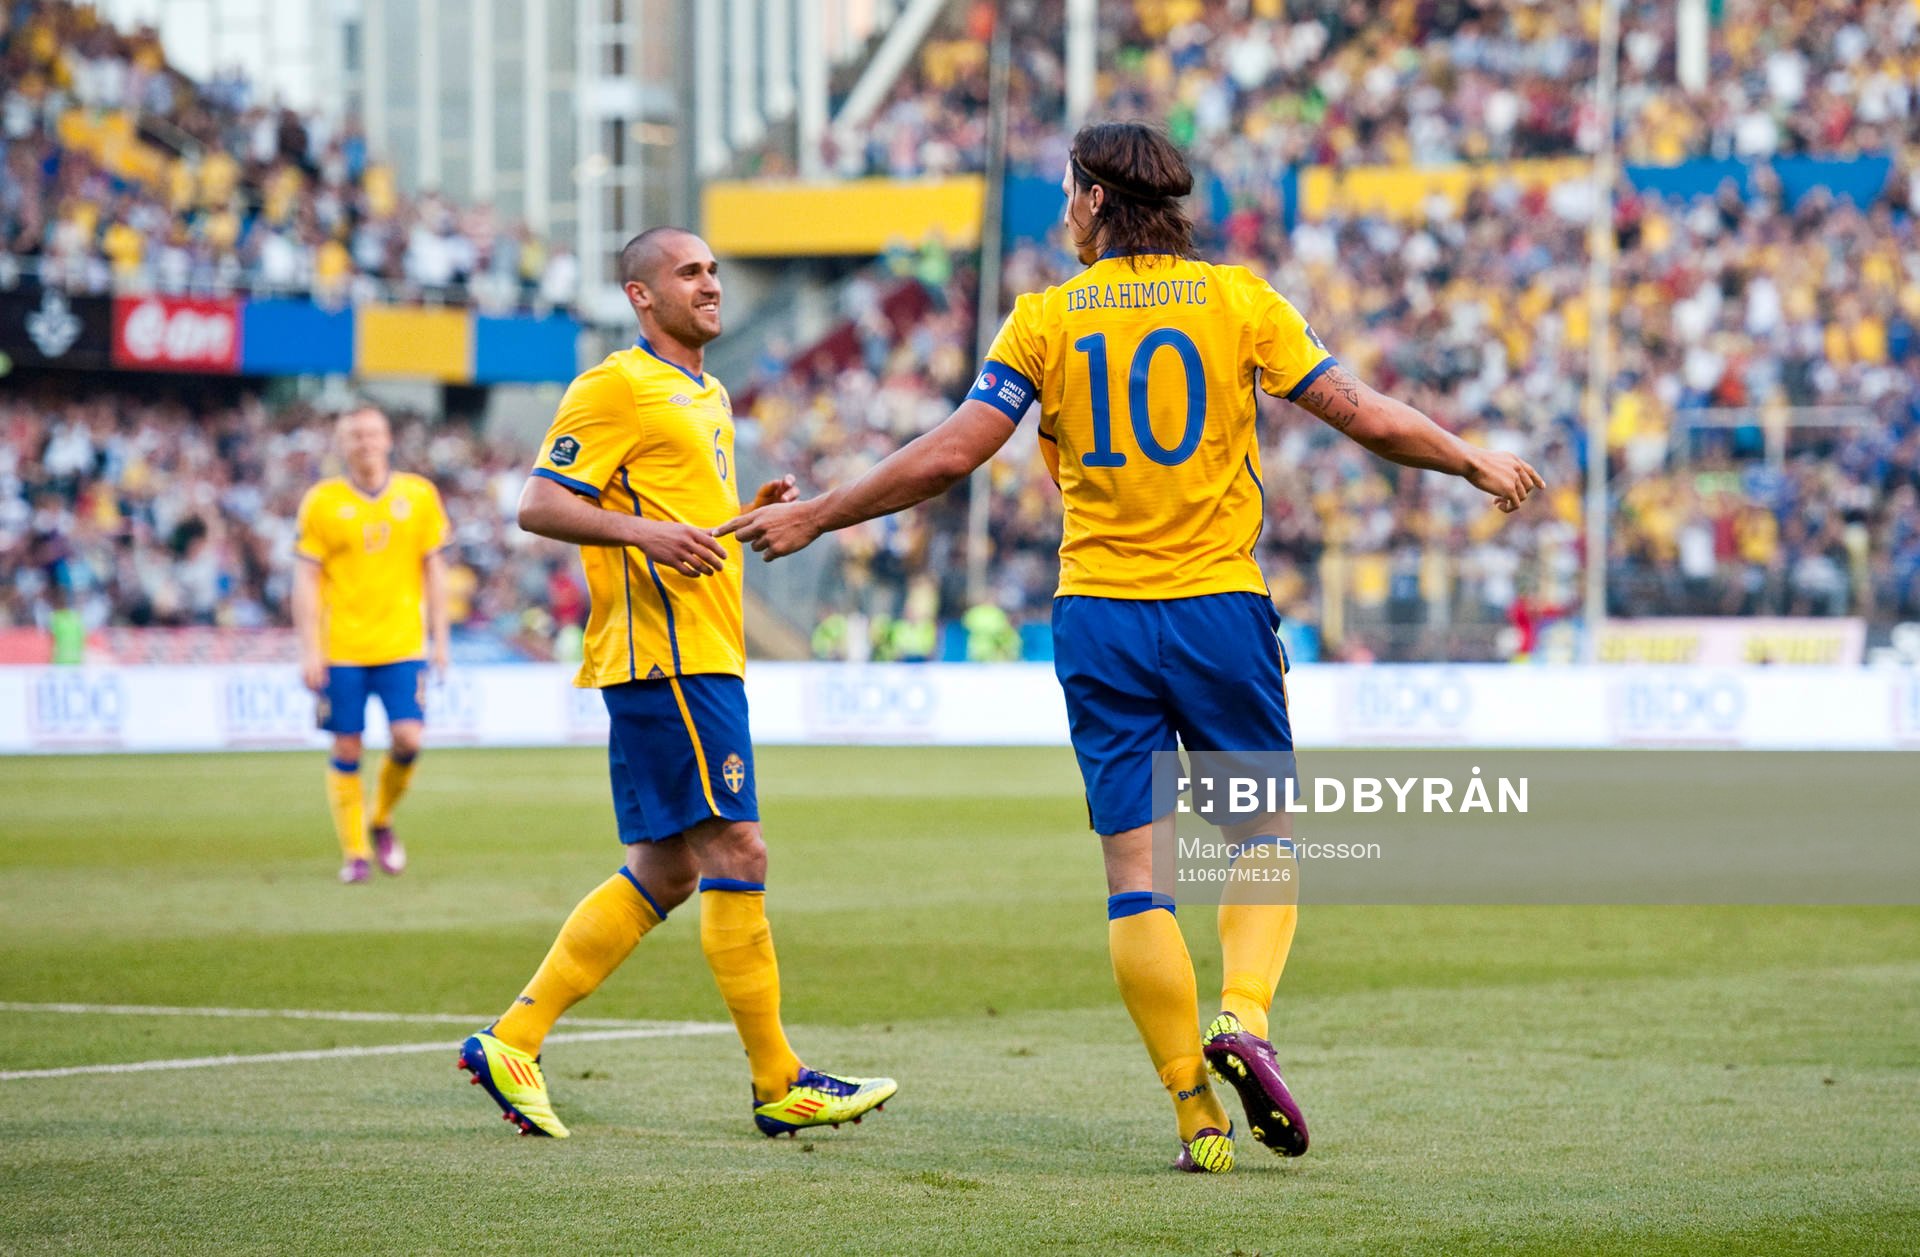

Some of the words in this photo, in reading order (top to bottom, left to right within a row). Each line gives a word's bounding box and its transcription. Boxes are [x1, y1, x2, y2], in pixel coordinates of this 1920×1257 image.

[1067, 277, 1207, 312] IBRAHIMOVIĆ
[997, 390, 1020, 410] RACISM
[1003, 379, 1026, 399] UNITE
[1074, 327, 1207, 468] 10
[714, 428, 727, 480] 6
